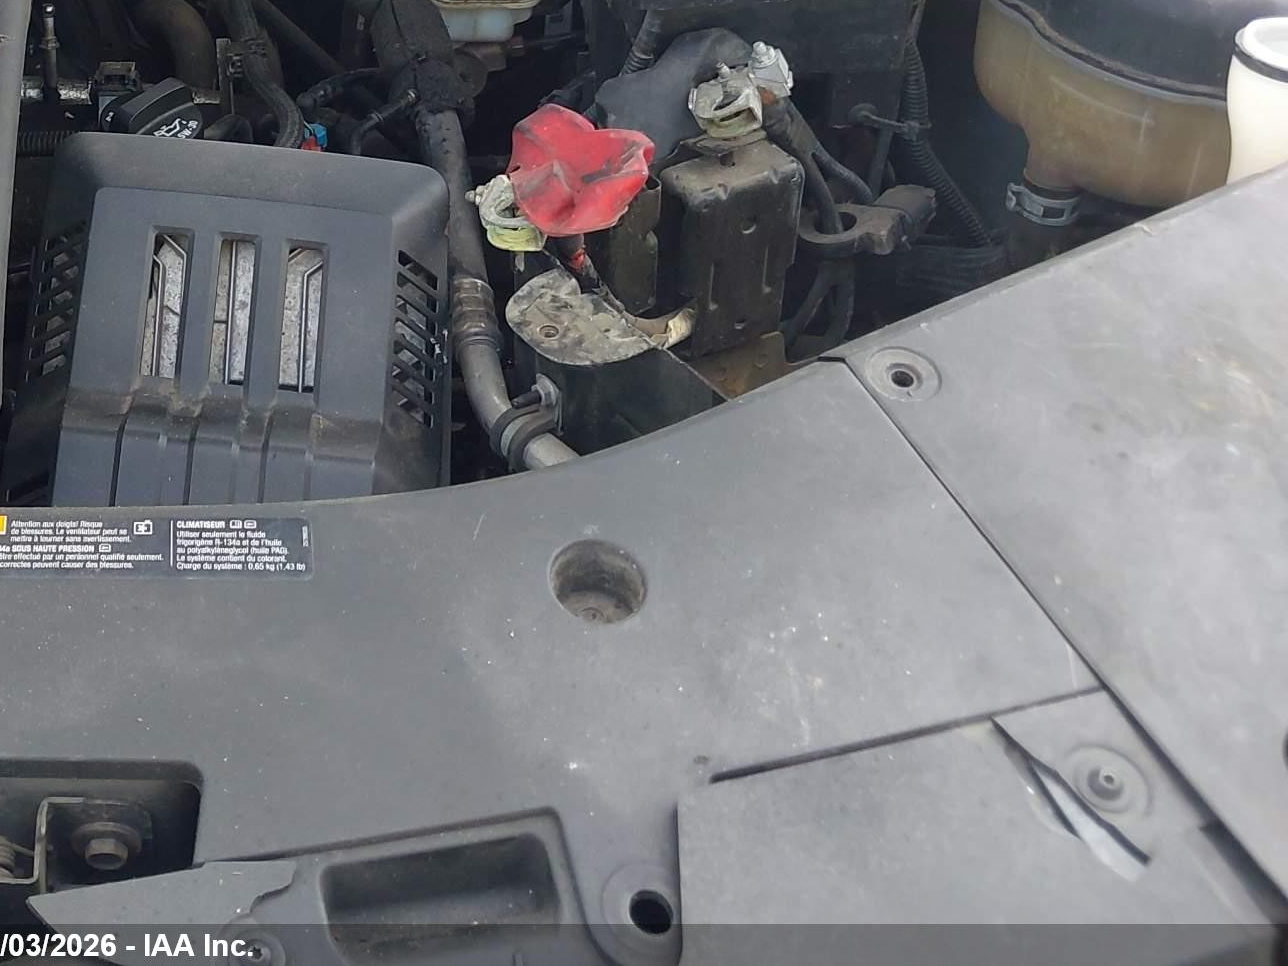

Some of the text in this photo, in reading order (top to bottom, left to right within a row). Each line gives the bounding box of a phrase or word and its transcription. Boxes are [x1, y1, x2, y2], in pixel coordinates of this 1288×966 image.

[176, 520, 226, 529] CLIMATISEUR
[176, 530, 201, 538] Utiliser
[201, 530, 238, 538] seulement
[246, 530, 266, 538] fluide
[214, 538, 241, 547] R-134a
[11, 544, 32, 552] SOUS
[32, 544, 57, 552] HAUTE
[58, 544, 95, 552] PRESSION
[216, 554, 245, 563] contient
[257, 554, 288, 563] colorant.
[176, 562, 202, 571] Charge
